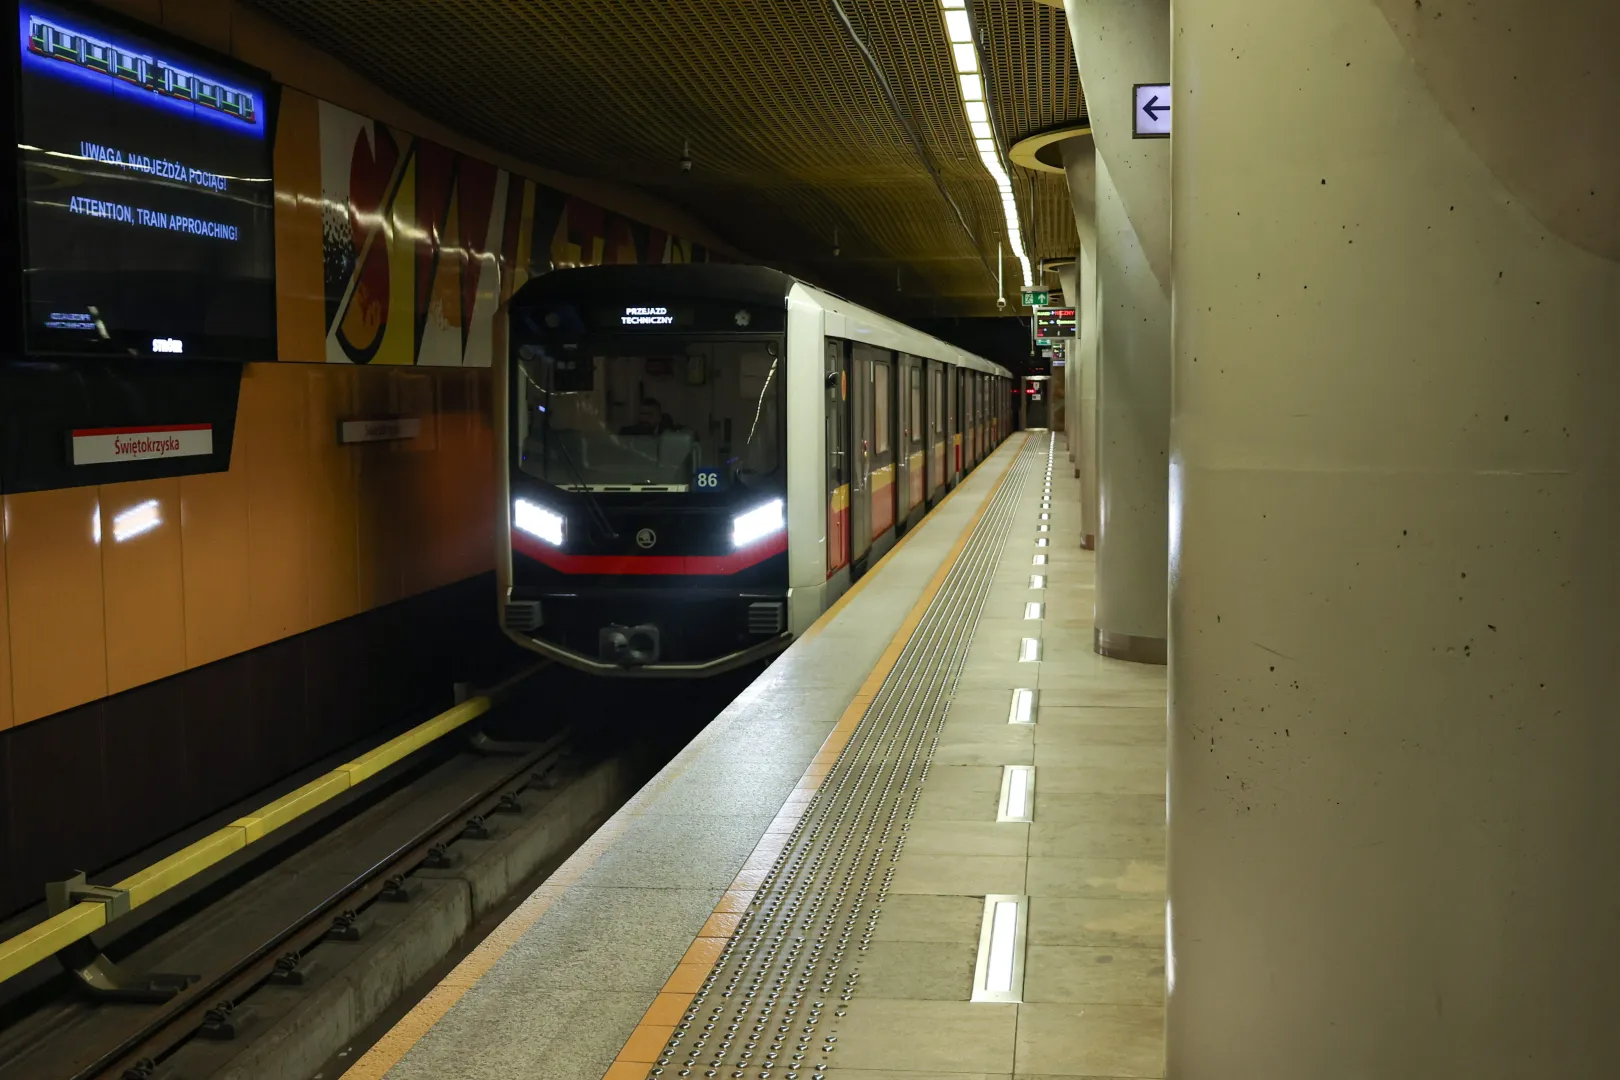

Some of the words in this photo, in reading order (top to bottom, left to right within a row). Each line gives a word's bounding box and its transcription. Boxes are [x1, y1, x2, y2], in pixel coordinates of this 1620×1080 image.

[80, 141, 126, 170] UWAGA,
[128, 153, 187, 183] NADJEŻDŻA
[189, 168, 227, 192] POCIĄG!
[69, 196, 135, 226] ATTENTION,
[137, 208, 168, 229] TRAIN
[169, 215, 238, 241] APPROACHING!
[621, 316, 674, 325] TECHNICZNY
[625, 307, 668, 316] PRZEJAZD
[114, 435, 180, 457] Świętokrzyska
[697, 472, 718, 488] 86
